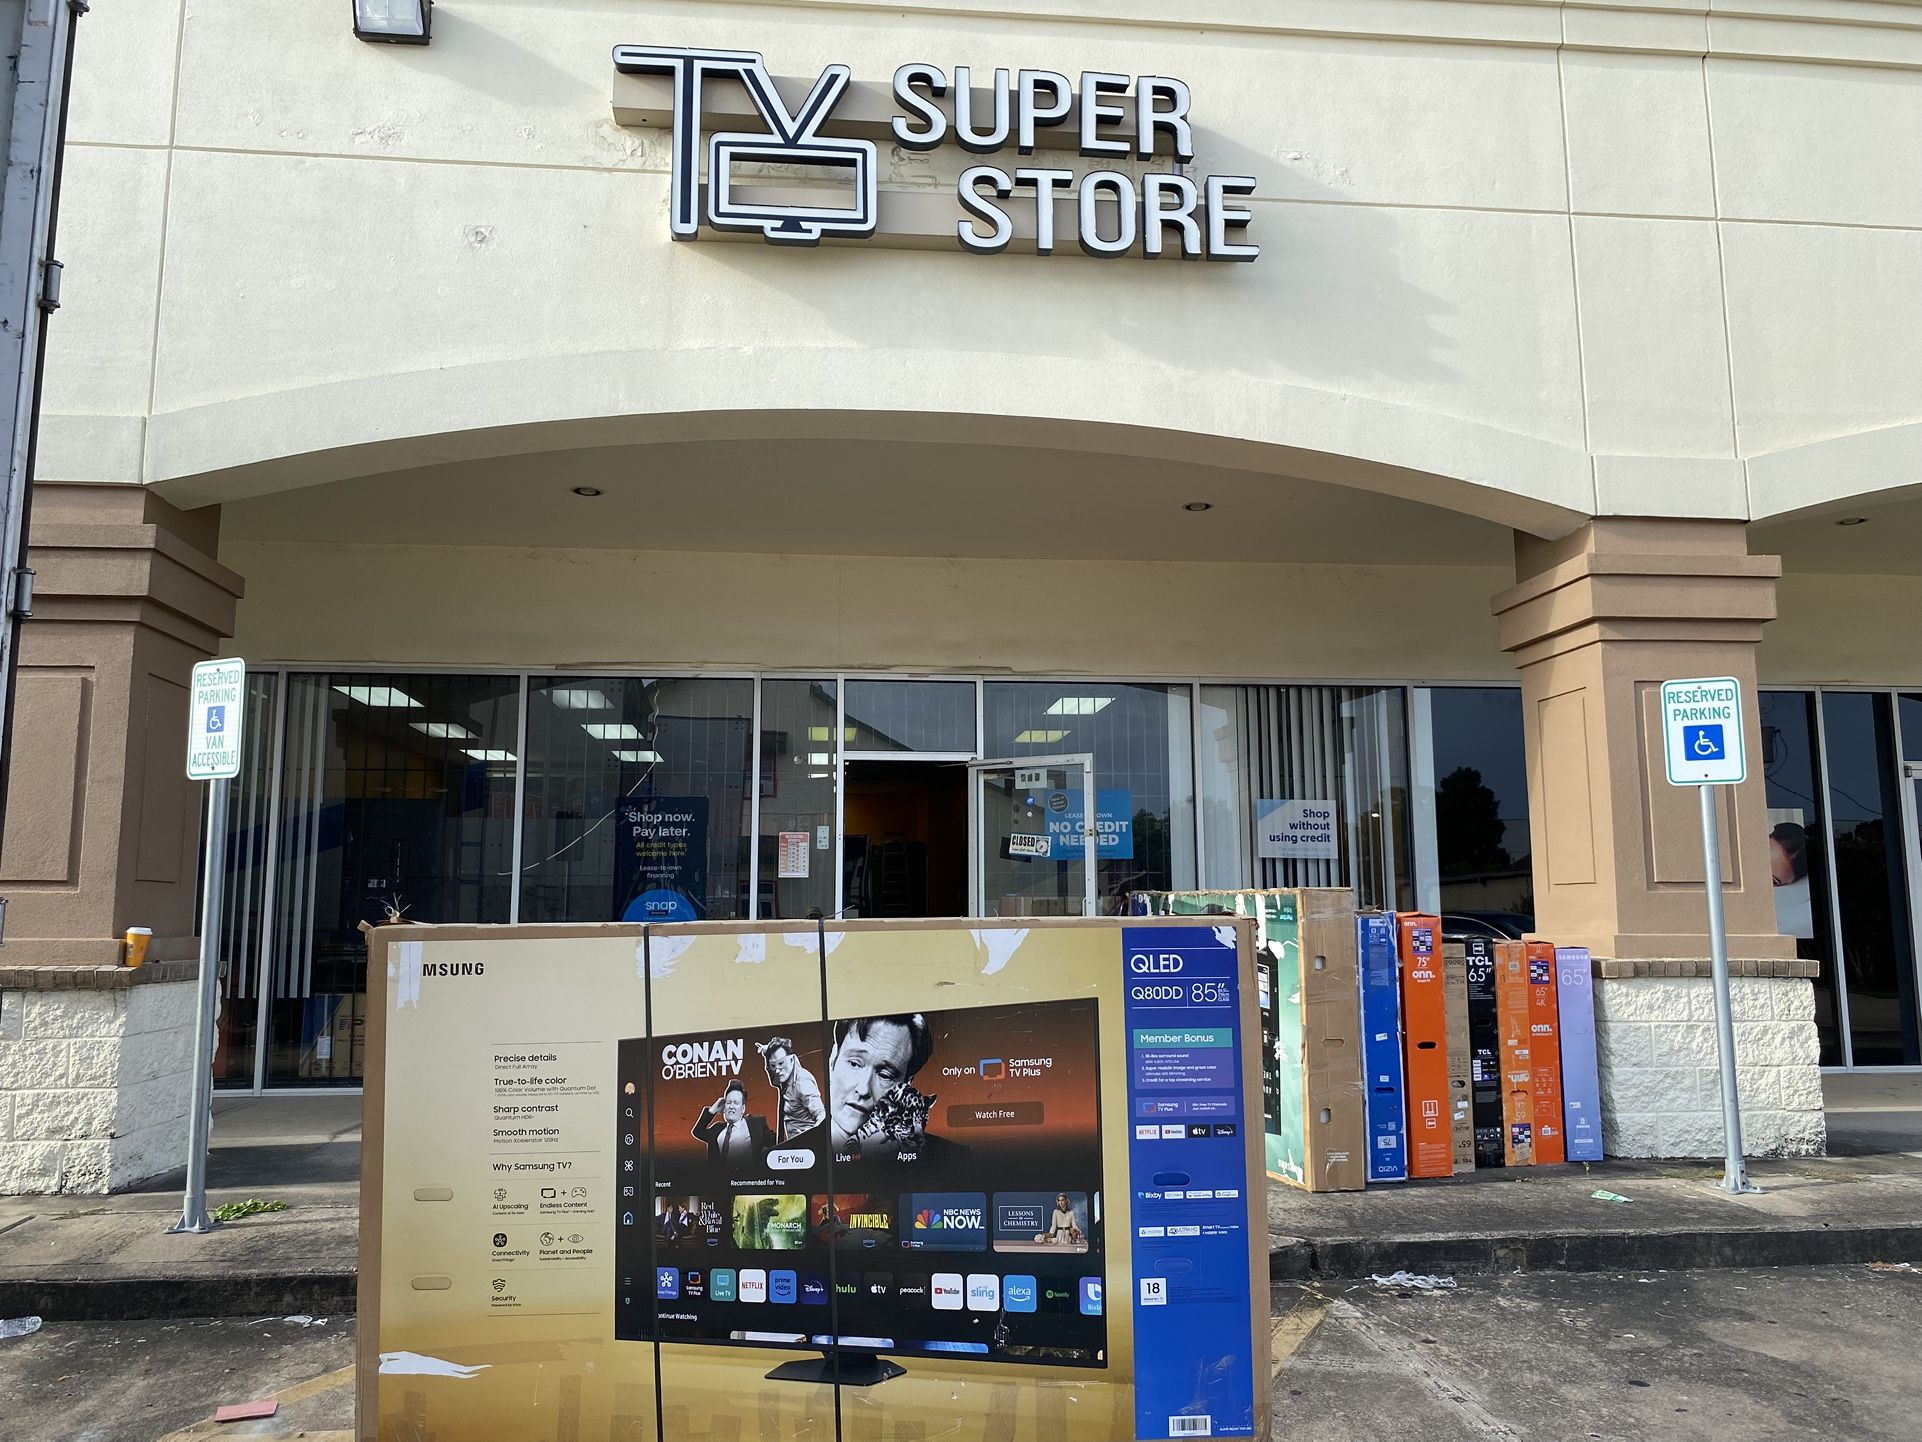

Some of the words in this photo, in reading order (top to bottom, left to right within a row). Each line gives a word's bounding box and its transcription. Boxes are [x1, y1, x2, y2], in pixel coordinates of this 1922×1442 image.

[891, 63, 1194, 163] SUPER
[613, 44, 858, 243] TV
[957, 165, 1260, 262] STORE
[197, 669, 239, 688] RESERVED
[198, 687, 236, 704] PARKING
[1668, 688, 1734, 704] RESERVED
[1673, 706, 1731, 721] PARKING
[206, 735, 224, 749] VAN
[192, 750, 236, 767] ACCESSIBLE
[628, 811, 662, 825] Shop
[665, 813, 696, 822] now.
[1303, 809, 1330, 820] Shop
[1050, 822, 1071, 832] NO
[1075, 822, 1129, 832] CEDIT
[1289, 821, 1330, 830] without
[633, 826, 656, 840] Pay
[658, 826, 691, 837] later.
[1012, 836, 1035, 847] CLOSED
[1269, 833, 1298, 844] using
[1300, 833, 1331, 842] credit
[645, 901, 677, 913] snap
[1130, 954, 1183, 973] QLED
[1466, 957, 1493, 965] TCL
[1412, 971, 1435, 979] onn.
[1468, 968, 1491, 981] 65"
[1131, 987, 1183, 1000] Q80DD
[1531, 1025, 1552, 1033] onn.
[1140, 1034, 1182, 1043] Member
[1184, 1034, 1214, 1042] Bonus
[662, 1039, 743, 1065] CONAN
[494, 1054, 526, 1062] Precise
[1009, 1058, 1052, 1067] Samsung
[942, 1067, 962, 1077] Only
[1010, 1069, 1020, 1077] TV
[1023, 1068, 1041, 1076] Plus
[494, 1077, 543, 1085] True-to-life
[494, 1106, 519, 1115] Sharp
[975, 1111, 997, 1119] Watch
[999, 1110, 1015, 1118] Free
[529, 1127, 559, 1135] motion
[790, 1155, 804, 1163] You
[836, 1153, 850, 1162] Live
[897, 1151, 917, 1161] Apps
[493, 1163, 512, 1173] Why
[514, 1163, 555, 1172] Samsung
[556, 1162, 572, 1170] TV?
[1145, 1192, 1162, 1200] Bixby
[701, 1202, 714, 1210] Red
[850, 1213, 889, 1229] INVINCIBLE
[741, 1282, 763, 1290] NETFLIX
[804, 1284, 824, 1294] Disney+
[836, 1284, 856, 1294] hulu
[900, 1286, 924, 1295] peacock
[1008, 1285, 1031, 1296] alexa
[1146, 1283, 1160, 1294] 18
[971, 1287, 995, 1300] sling
[675, 1313, 698, 1321] Watching
